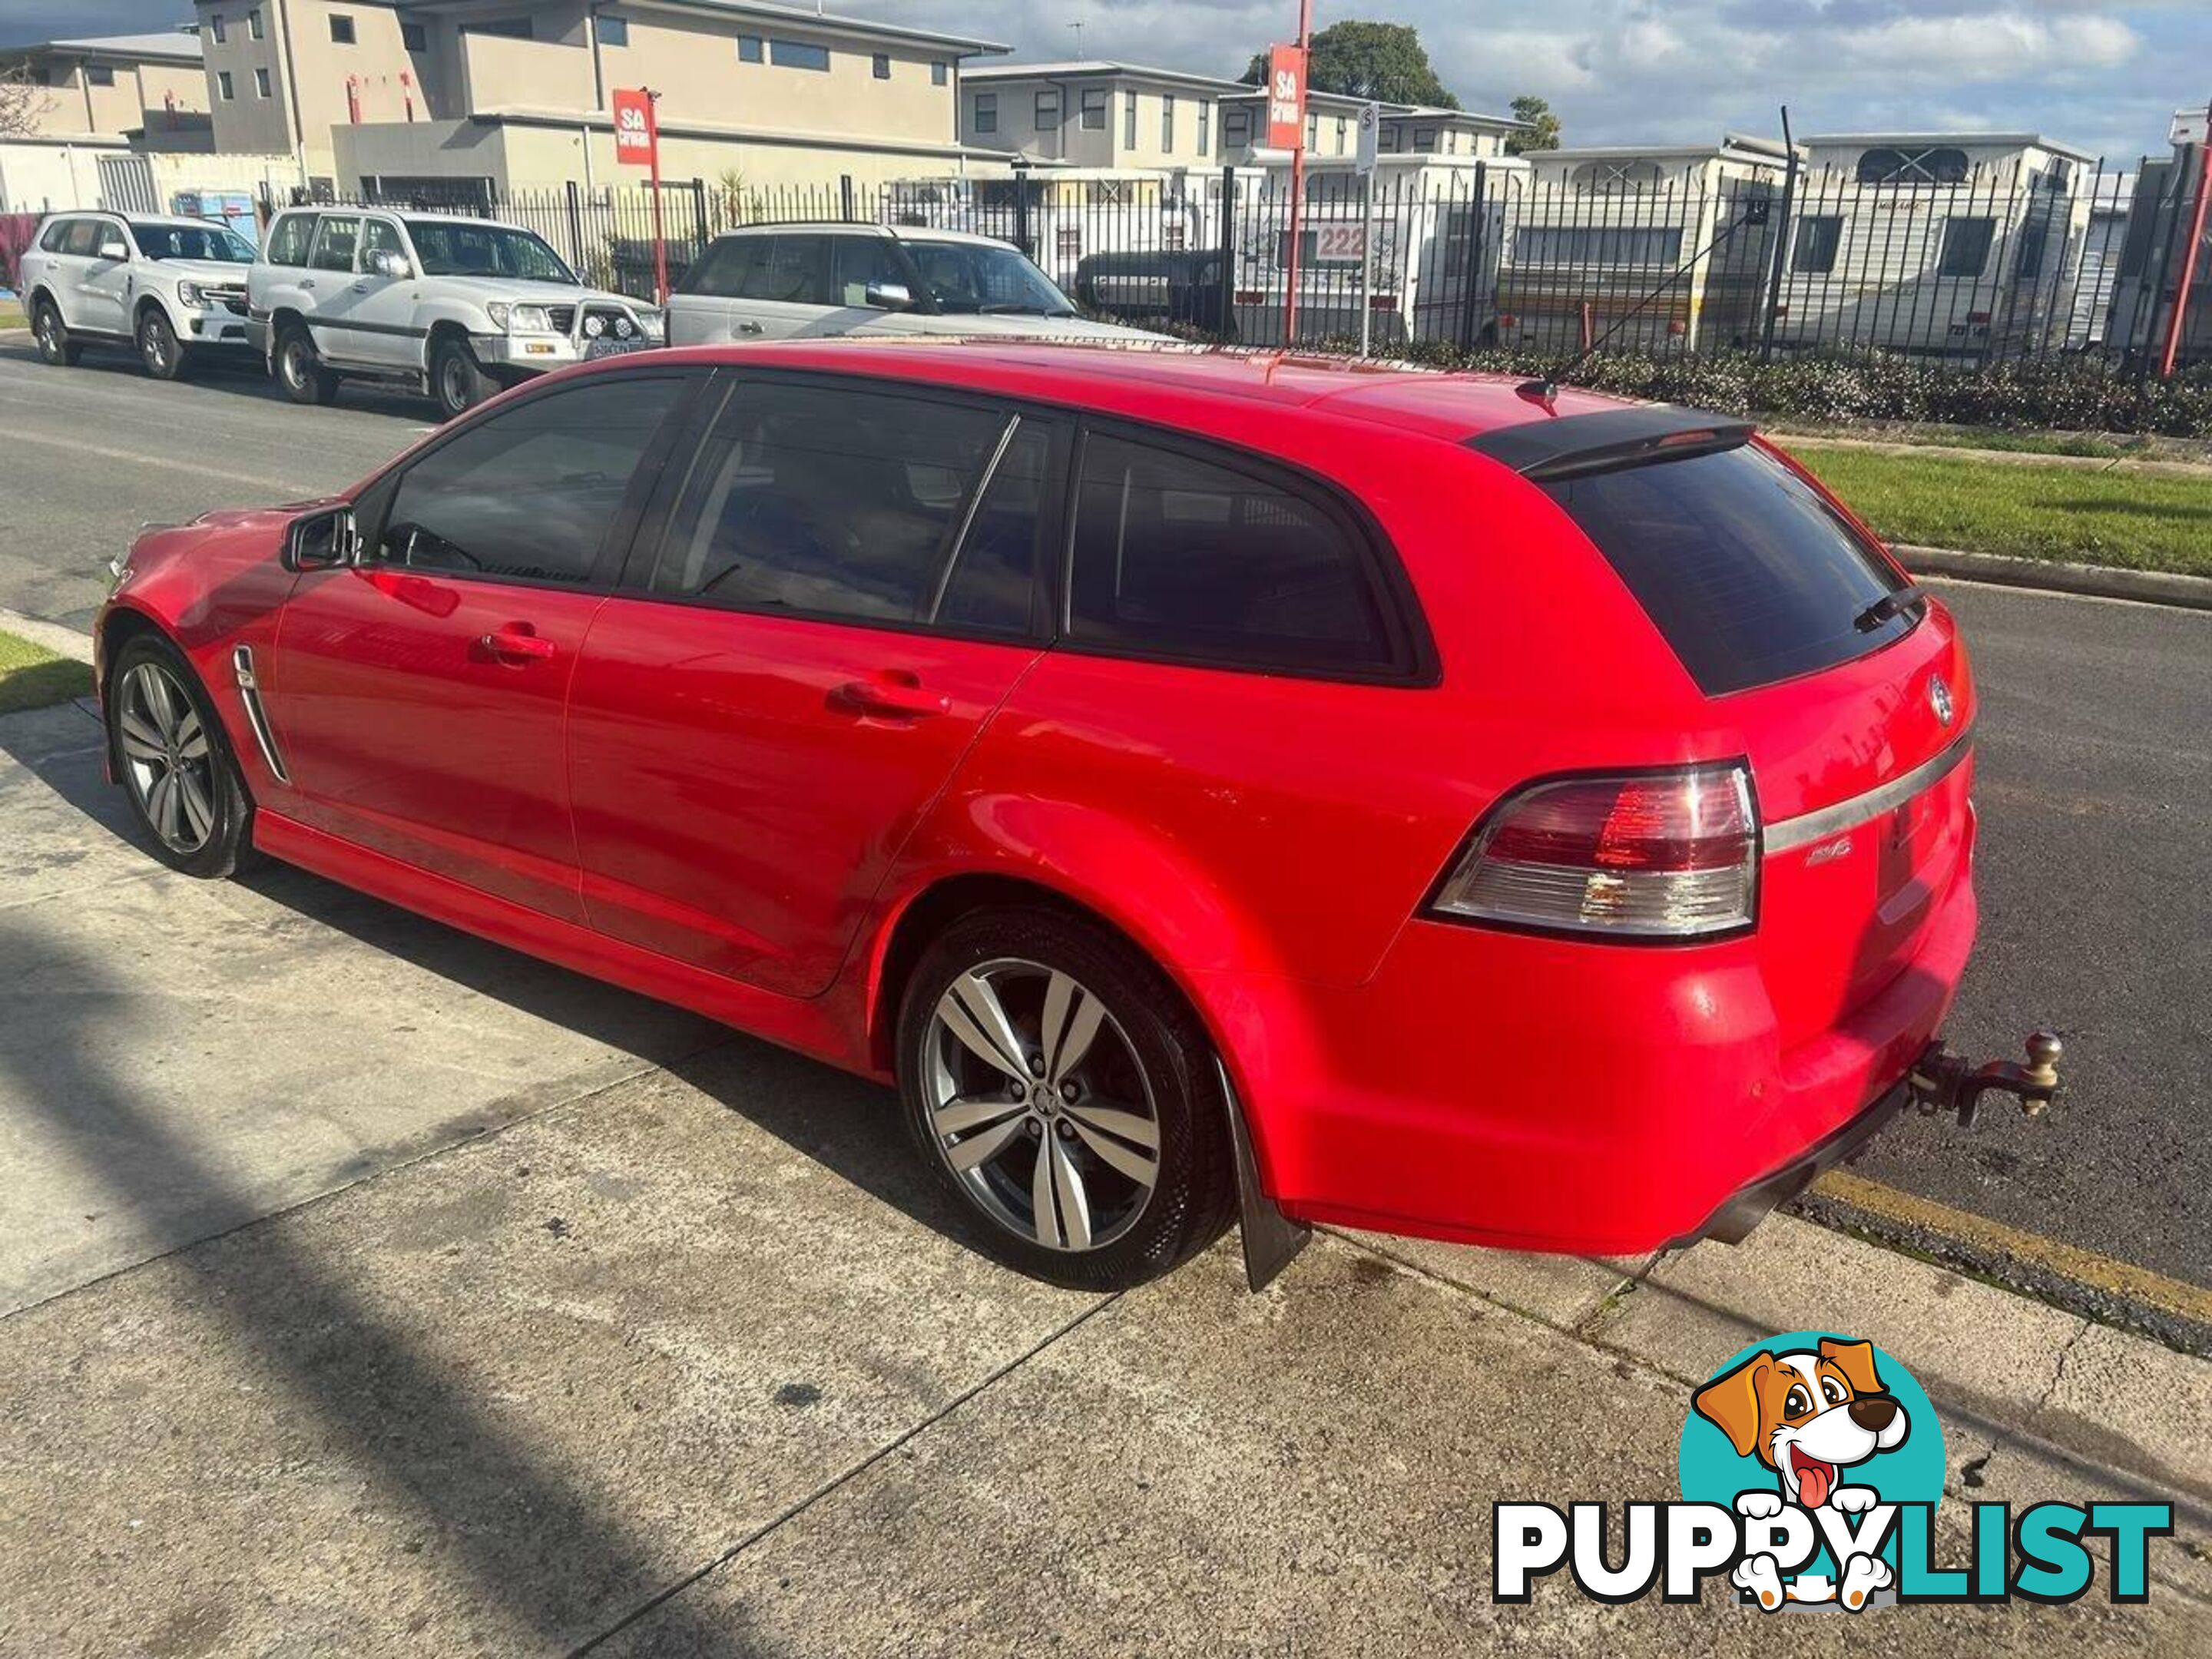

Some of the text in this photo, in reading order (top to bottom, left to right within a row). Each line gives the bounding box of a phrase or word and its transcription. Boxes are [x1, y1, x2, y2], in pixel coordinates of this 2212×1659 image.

[1276, 70, 1296, 100] SA
[621, 108, 646, 129] SA
[1320, 227, 1364, 256] 222
